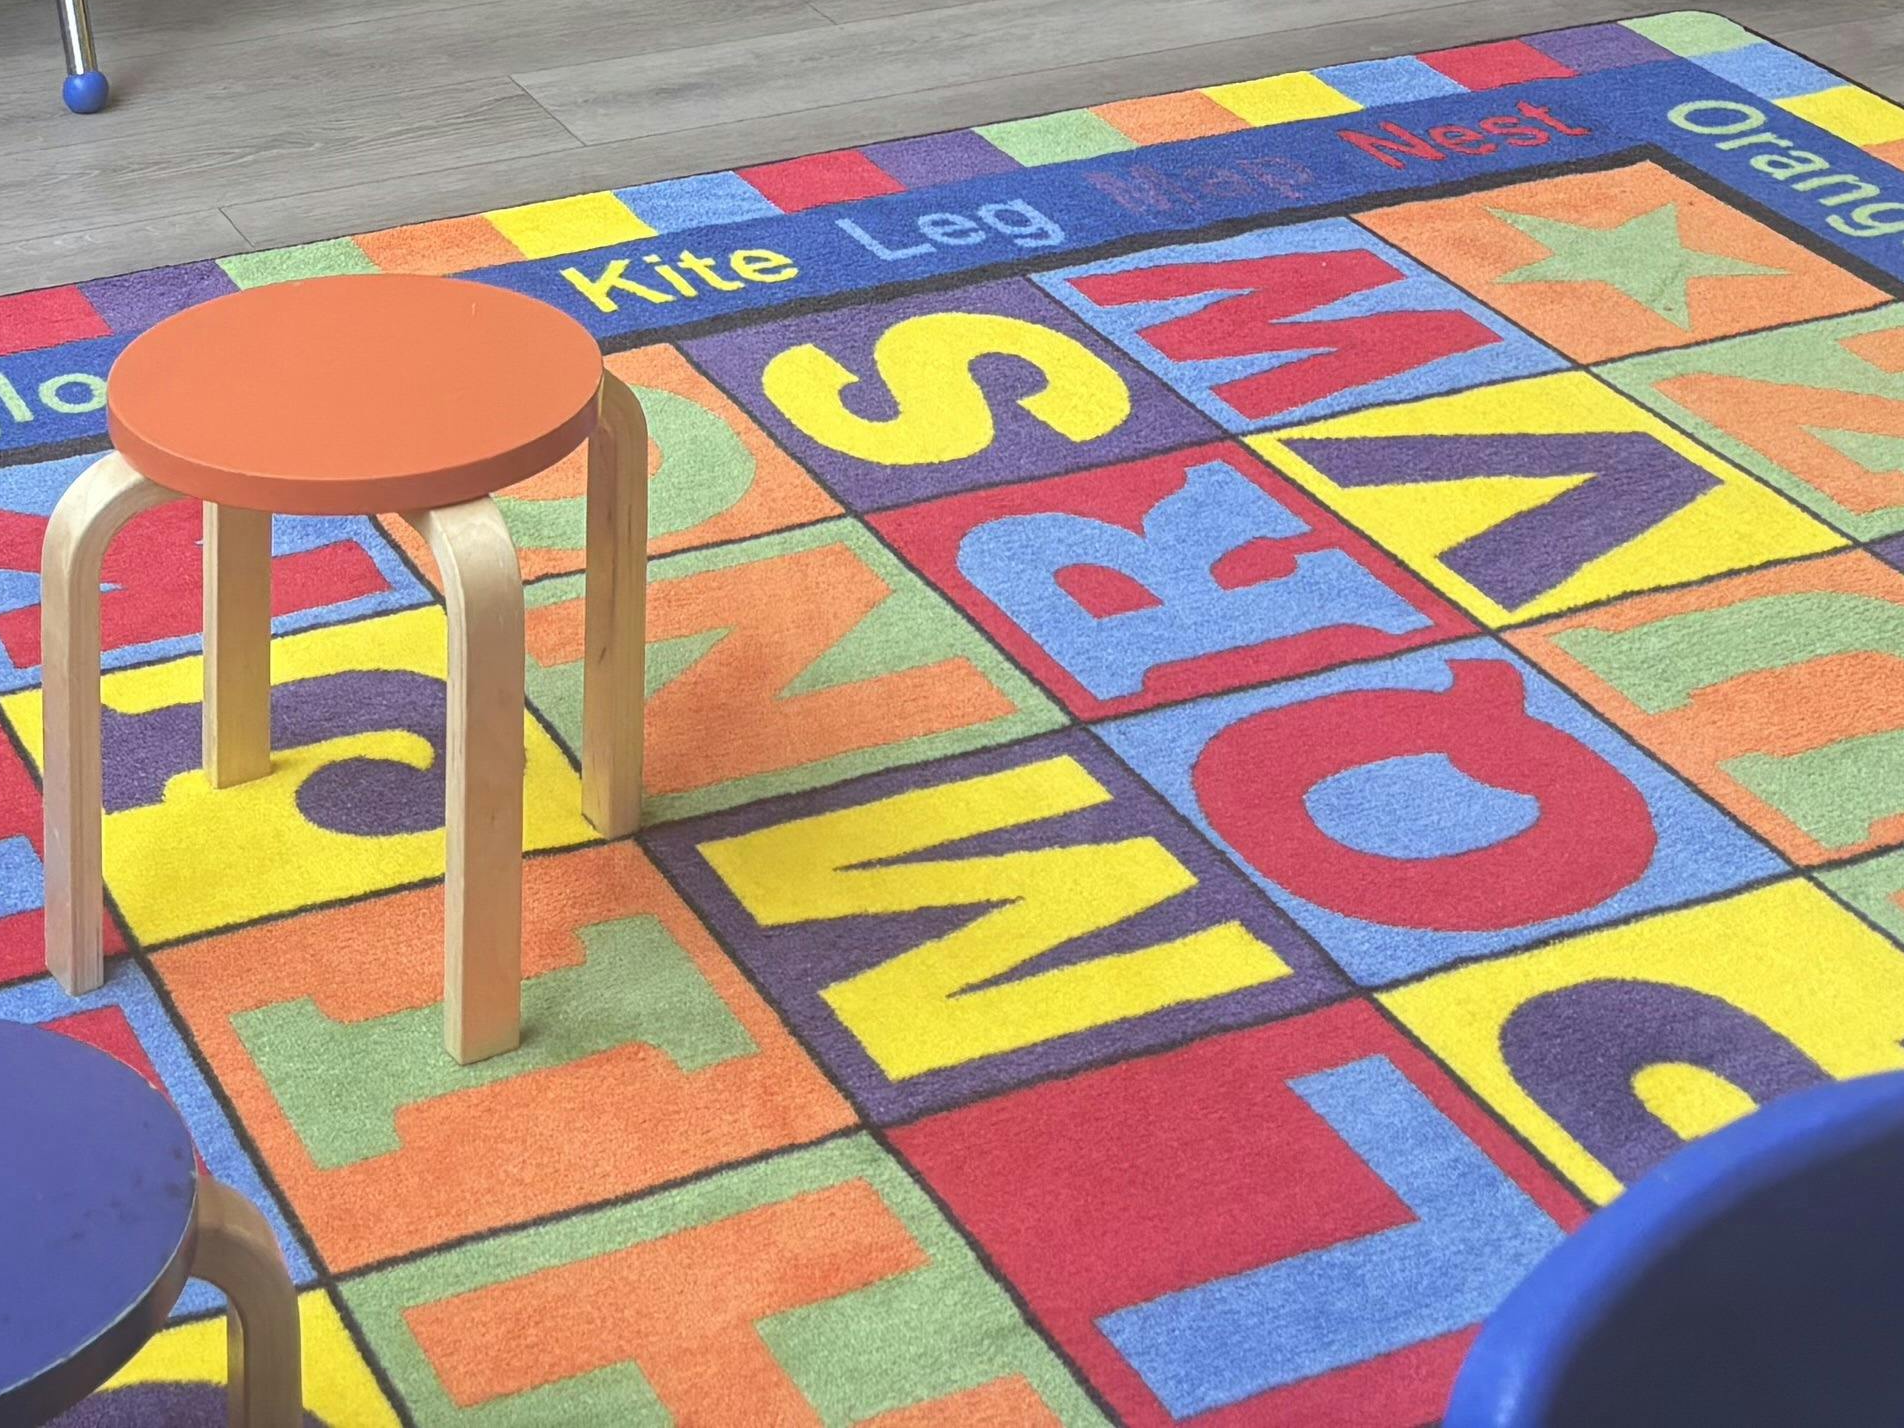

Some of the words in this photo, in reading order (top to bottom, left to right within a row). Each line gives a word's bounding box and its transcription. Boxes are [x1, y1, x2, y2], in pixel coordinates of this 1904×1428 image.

[834, 197, 1066, 262] Leg
[1338, 99, 1587, 170] Nest
[559, 243, 800, 313] Kite
[761, 310, 1132, 467] S
[954, 458, 1439, 701] R
[1191, 655, 1659, 933] Q
[695, 752, 1295, 1081] M
[1091, 1053, 1571, 1423] L
